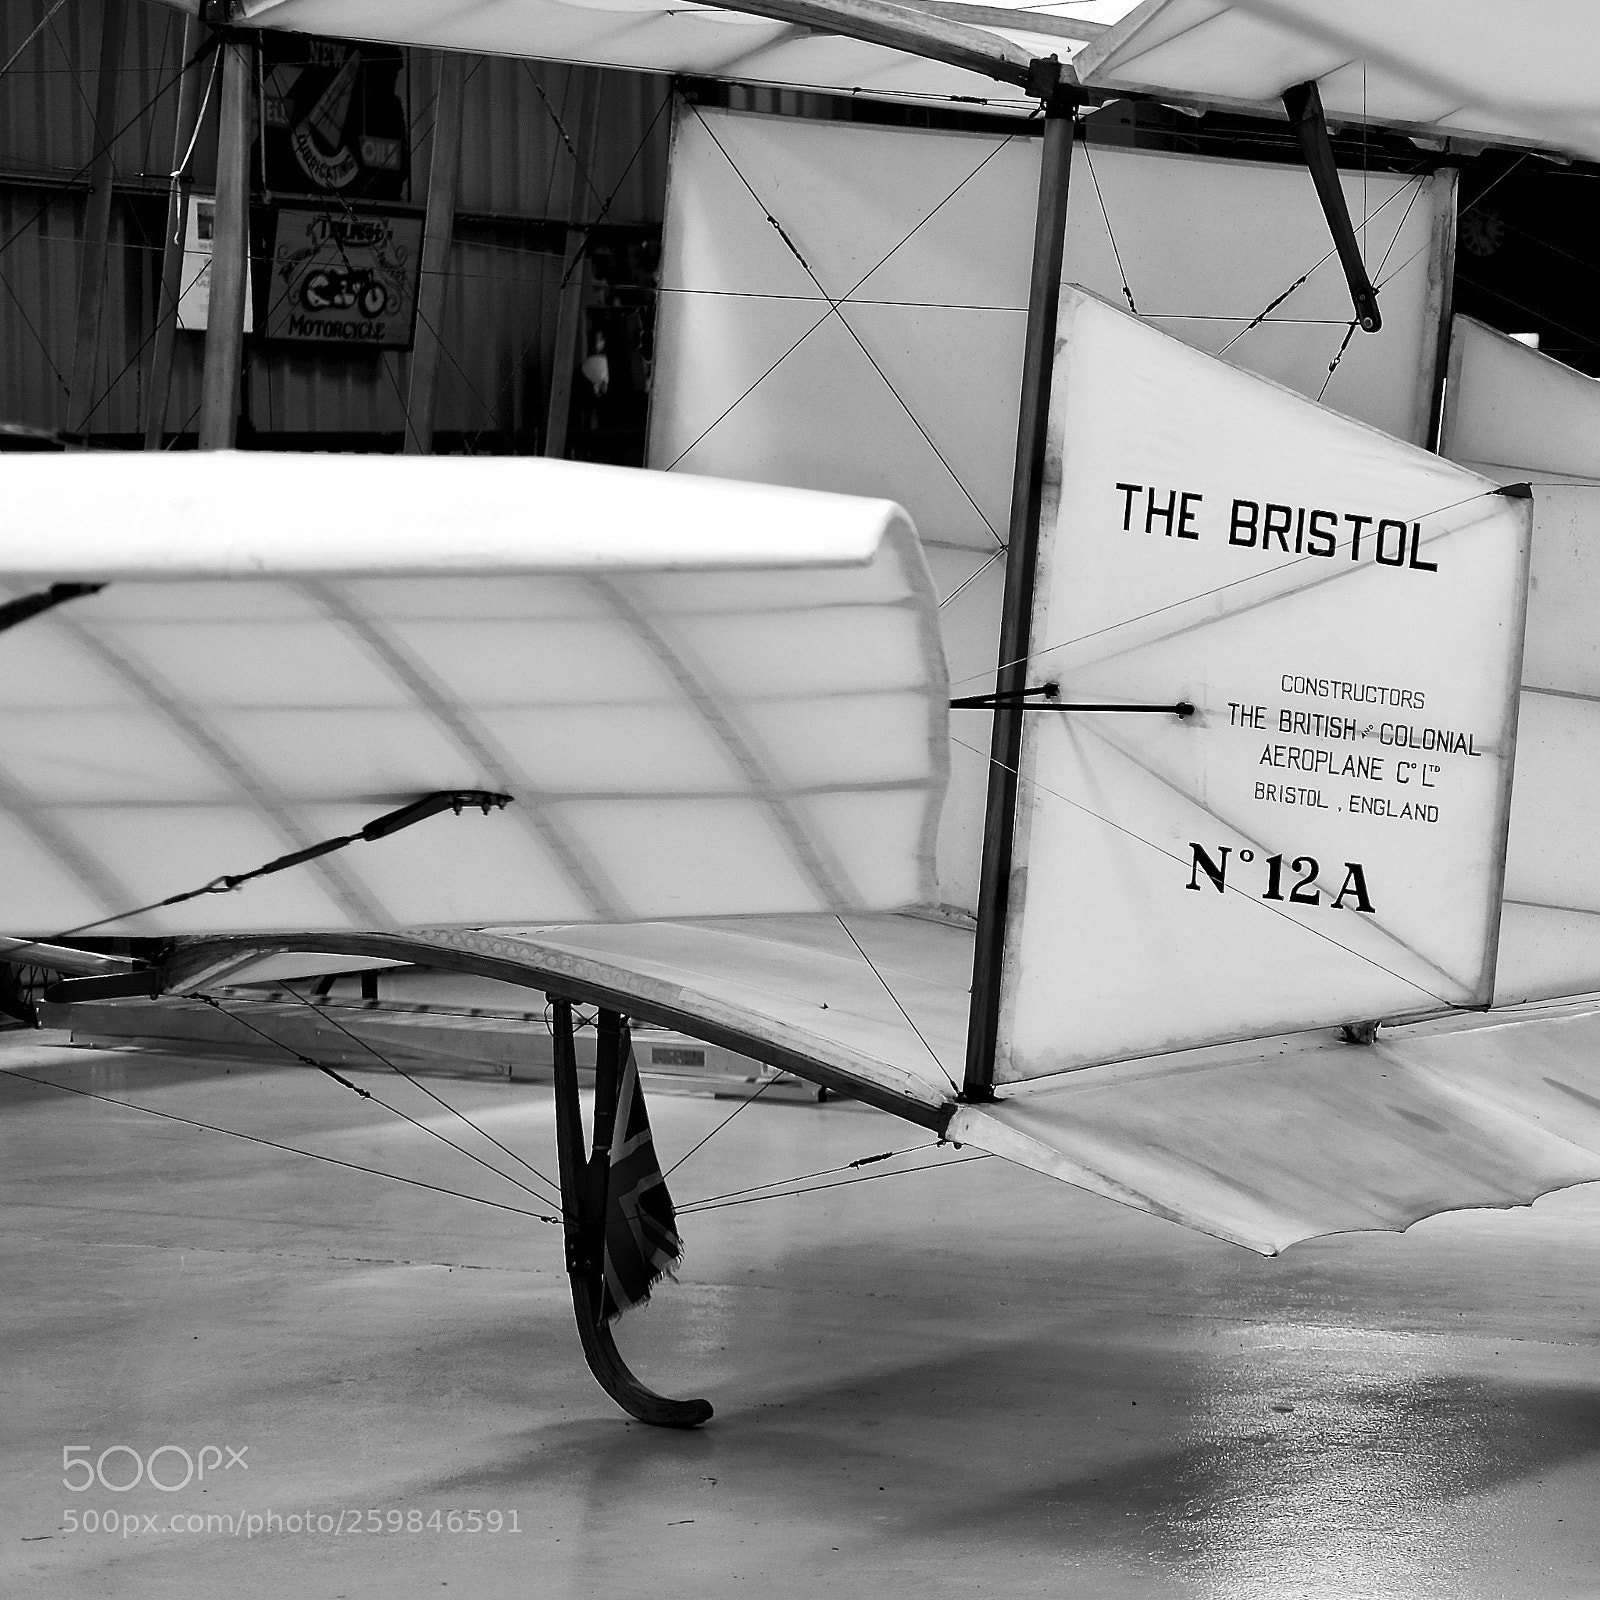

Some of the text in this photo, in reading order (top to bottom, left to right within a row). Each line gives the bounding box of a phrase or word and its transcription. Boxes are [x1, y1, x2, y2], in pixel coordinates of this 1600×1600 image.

[308, 40, 347, 68] NEW
[288, 314, 386, 340] MOTORCYCLE
[1116, 483, 1438, 573] THE BRISTOL
[1281, 674, 1425, 709] CONSTRUCTORS
[1228, 703, 1268, 730] THE
[1278, 709, 1357, 741] BRITISH
[1380, 722, 1482, 757] COLONIAL
[1259, 743, 1385, 781] AEROPLANE
[1349, 794, 1439, 823] ENGLAND
